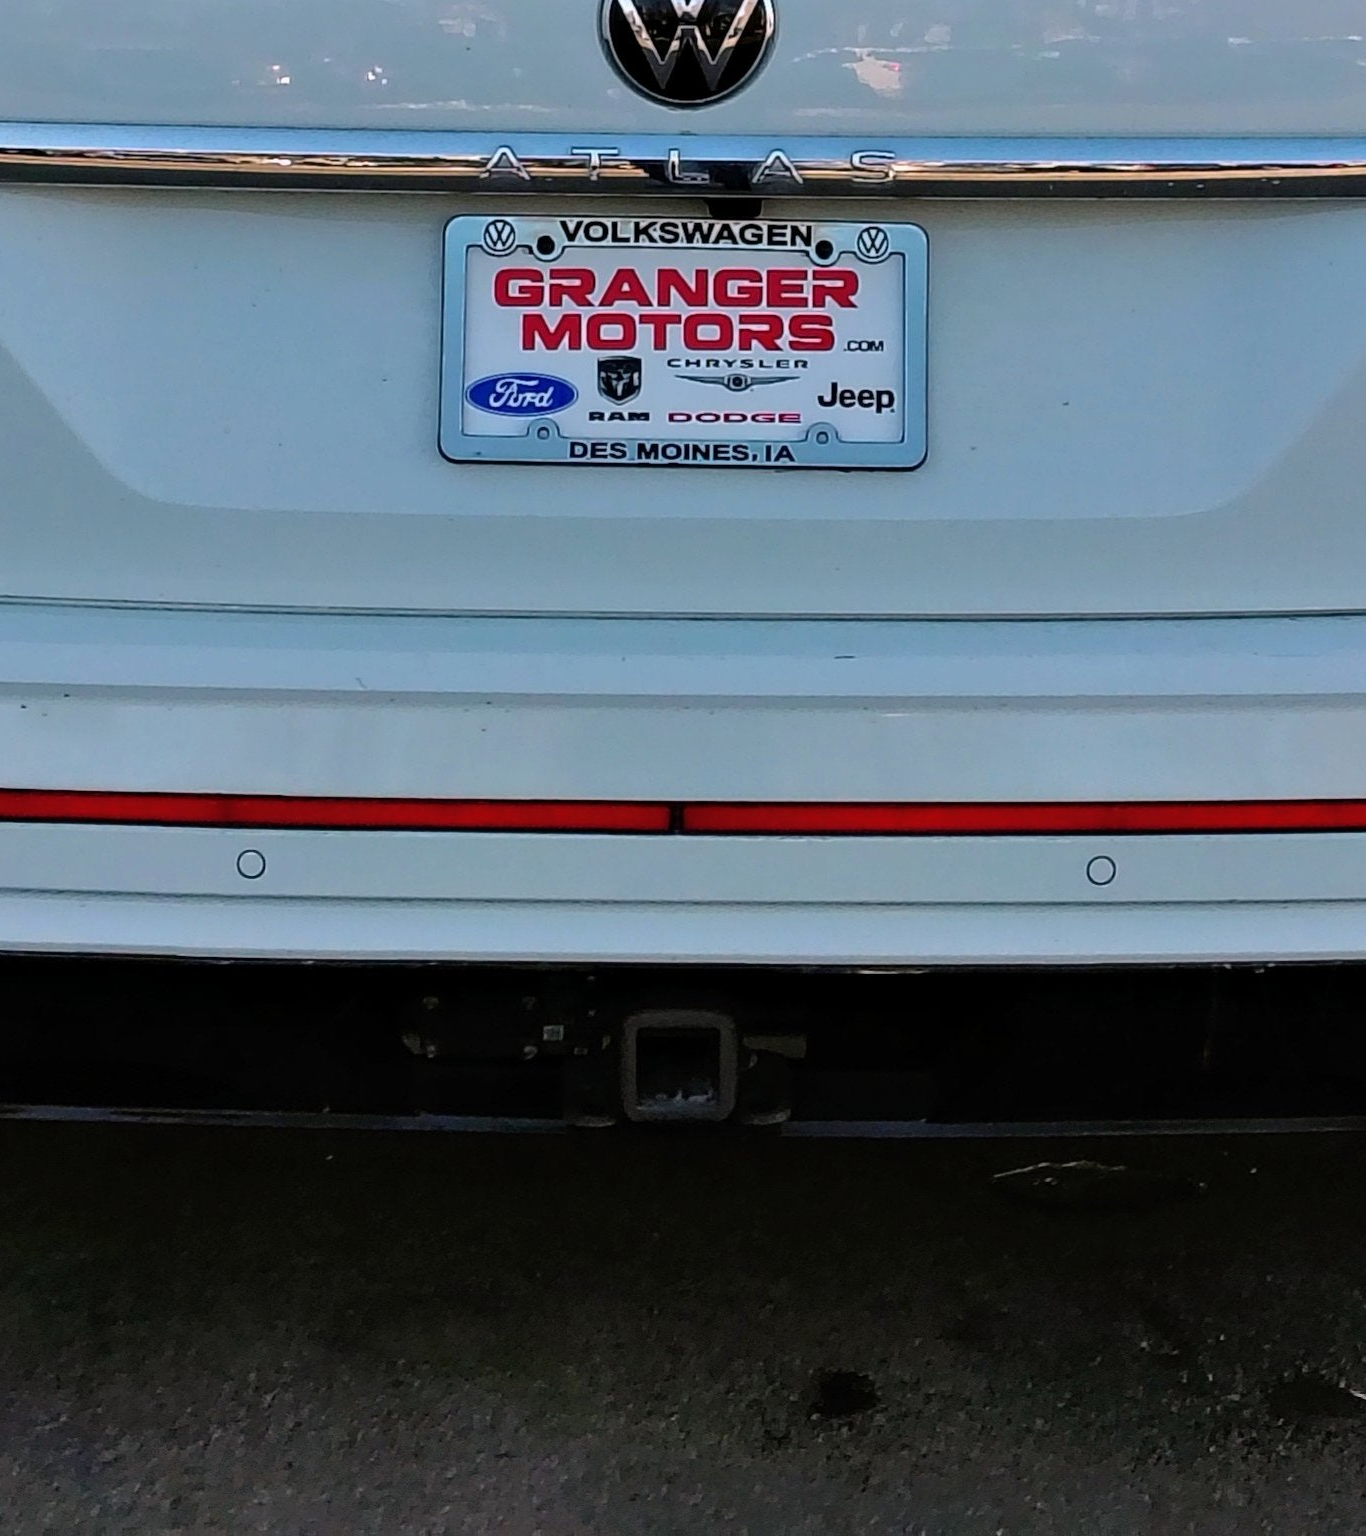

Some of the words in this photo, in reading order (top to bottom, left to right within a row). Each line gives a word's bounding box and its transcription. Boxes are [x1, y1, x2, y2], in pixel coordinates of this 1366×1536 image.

[478, 145, 898, 185] ATLAS
[560, 219, 813, 248] VOLKSWAGEN
[493, 268, 860, 309] GRANGER
[520, 312, 837, 352] MOTORS
[843, 339, 885, 353] .COM
[666, 357, 809, 369] CHRYSLER
[488, 380, 555, 410] Ford
[817, 381, 896, 414] Jeep
[588, 411, 651, 422] RAM
[668, 412, 803, 424] DODGE
[569, 441, 628, 460] DES
[637, 442, 761, 464] MOINES,
[765, 444, 797, 463] IA
